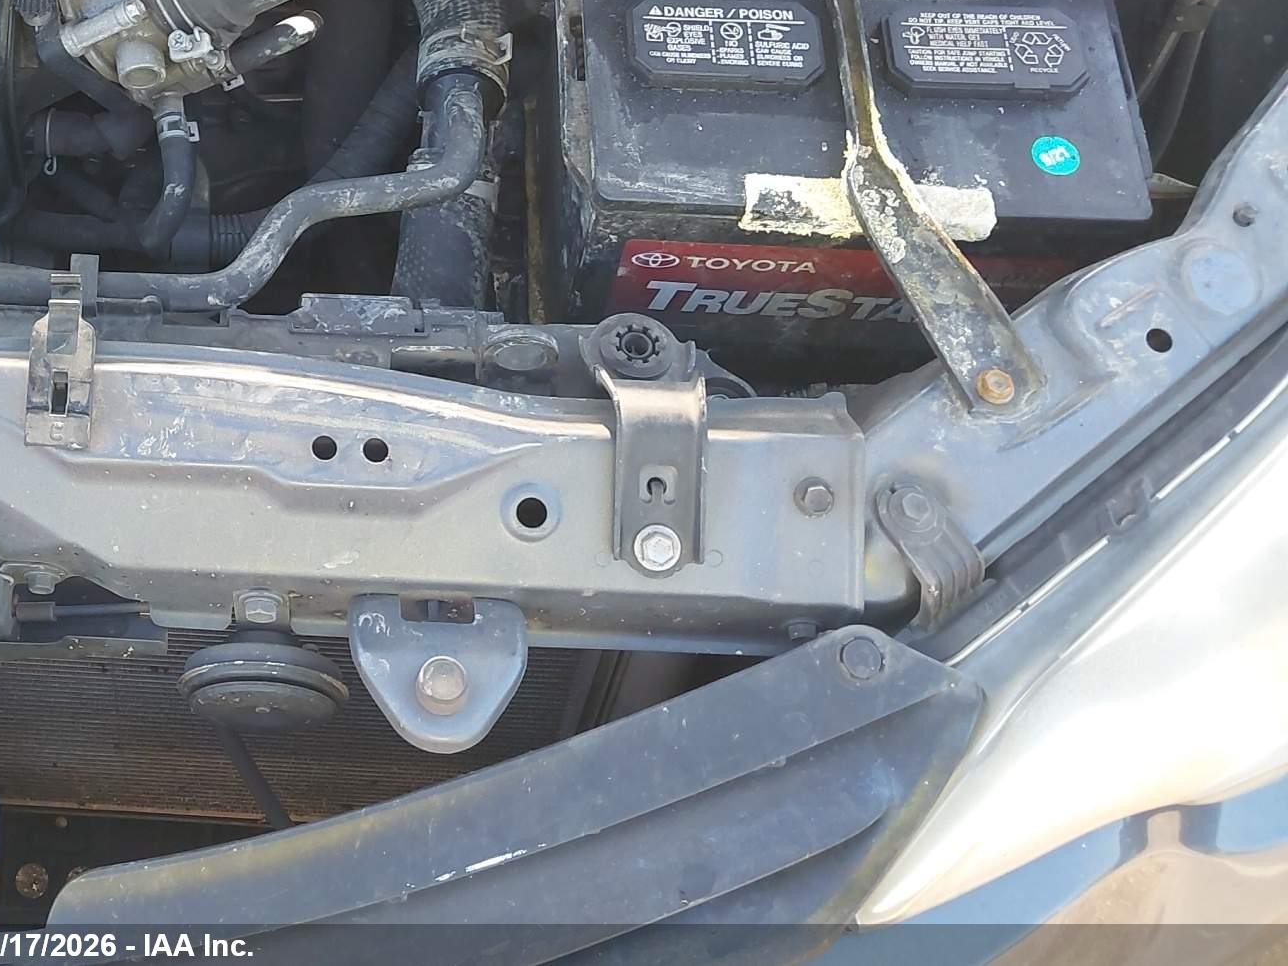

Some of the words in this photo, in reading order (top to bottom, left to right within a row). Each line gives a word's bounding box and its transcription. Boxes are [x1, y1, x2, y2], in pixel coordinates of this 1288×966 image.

[663, 6, 724, 18] DANGER
[727, 9, 736, 18] /
[739, 9, 793, 20] POISON
[687, 256, 816, 274] TOYOTA
[647, 280, 914, 323] TRUESTA
